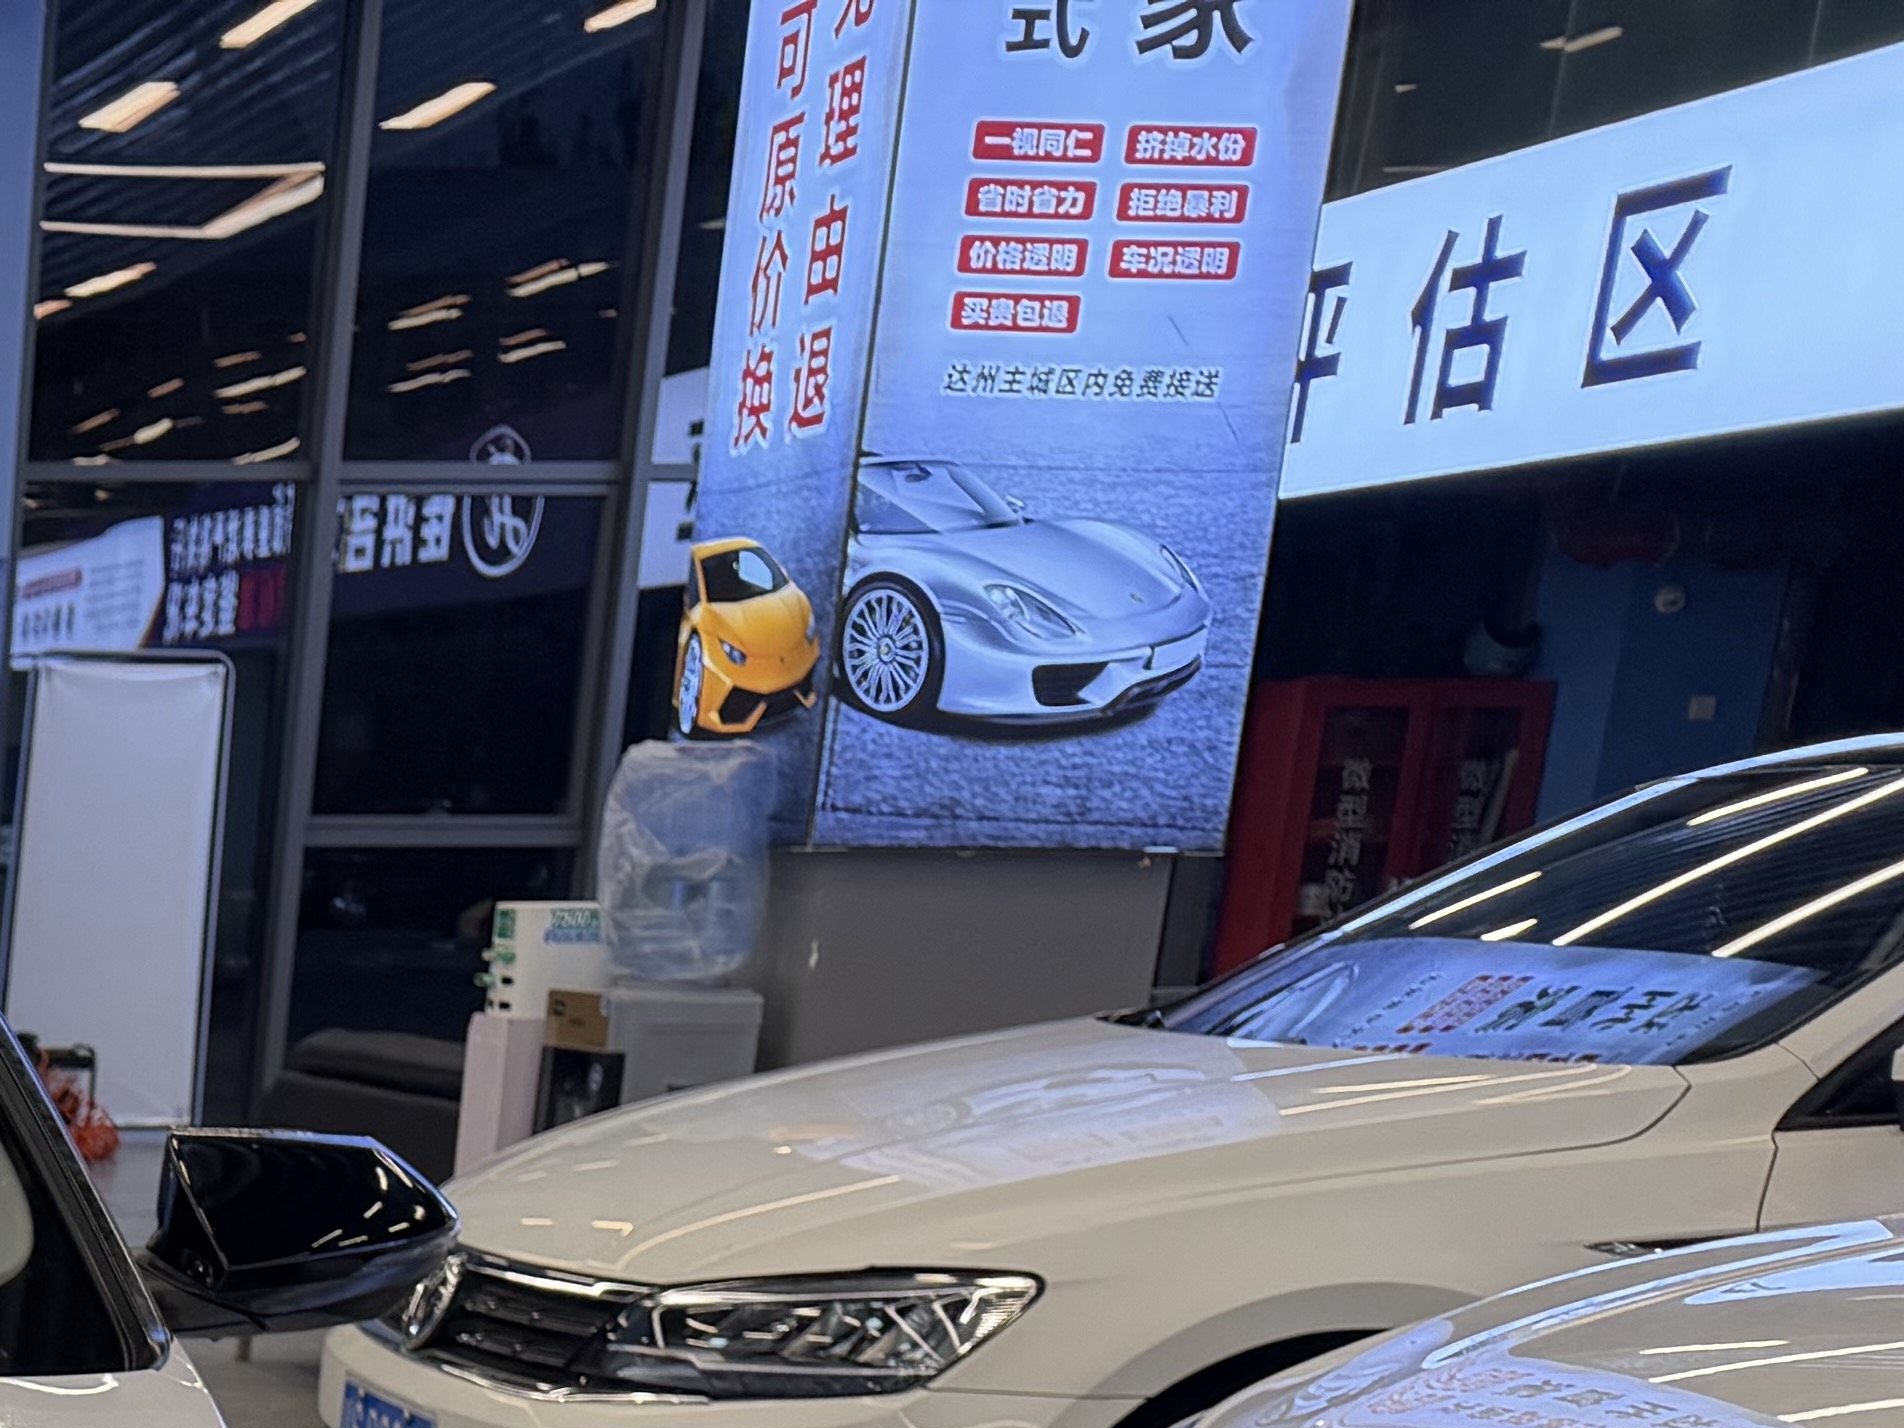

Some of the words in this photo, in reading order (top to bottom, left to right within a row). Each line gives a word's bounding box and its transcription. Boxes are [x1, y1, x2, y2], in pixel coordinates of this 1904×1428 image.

[984, 127, 1094, 157] 一视同仁
[1135, 130, 1245, 161] 挤掉水份
[977, 184, 1086, 215] 省时省力
[1127, 187, 1238, 218] 拒绝暴利
[969, 240, 1079, 272] 价格透明
[1119, 245, 1229, 274] 车况透明
[960, 297, 1069, 328] 买贵包退
[944, 364, 1220, 398] 达州主城区内免费接送
[1321, 757, 1373, 920] 微型消防
